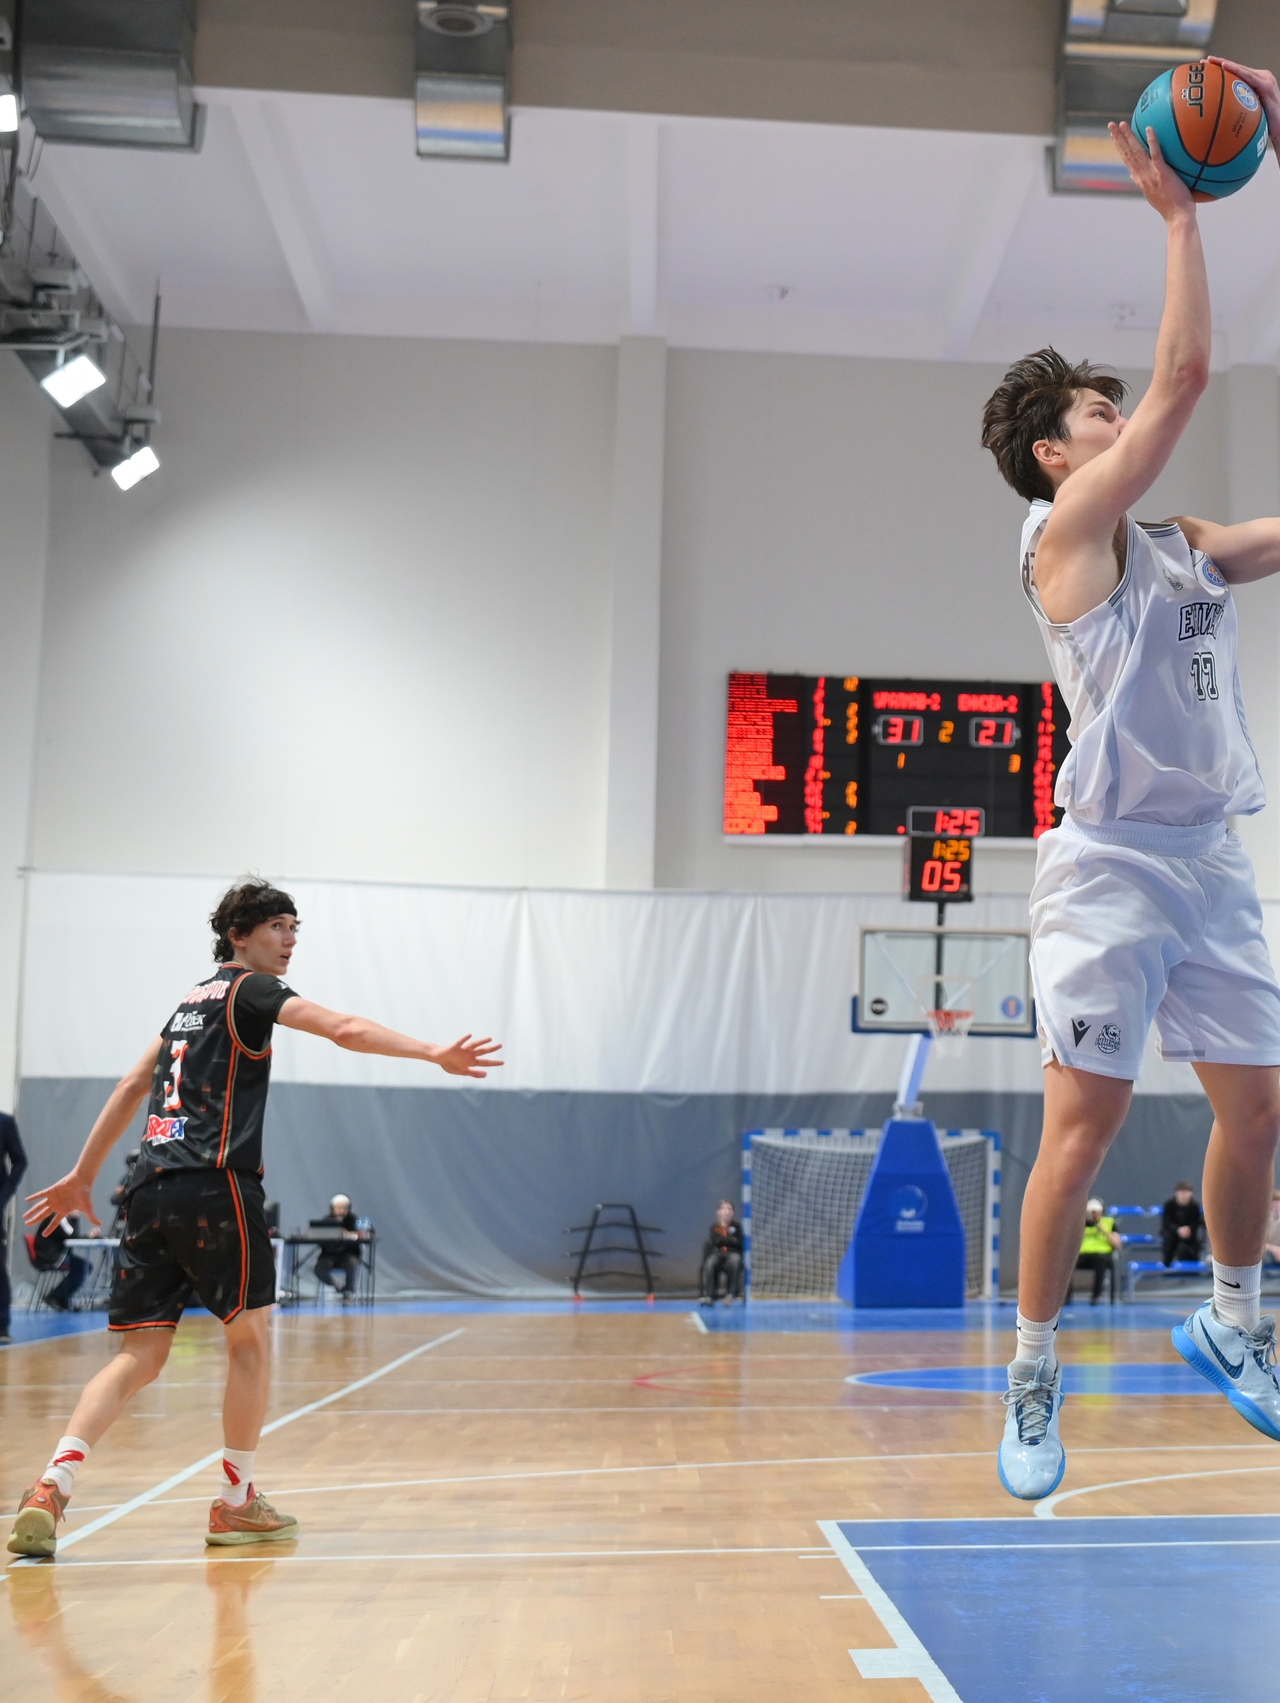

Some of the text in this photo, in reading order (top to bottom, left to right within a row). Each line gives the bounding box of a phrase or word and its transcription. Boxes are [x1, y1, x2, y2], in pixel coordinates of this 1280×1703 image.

[1182, 64, 1205, 118] JÖGE
[887, 717, 1012, 746] 31 2 21
[934, 809, 981, 836] 1:25
[932, 839, 971, 861] 1:25
[921, 860, 962, 893] 05
